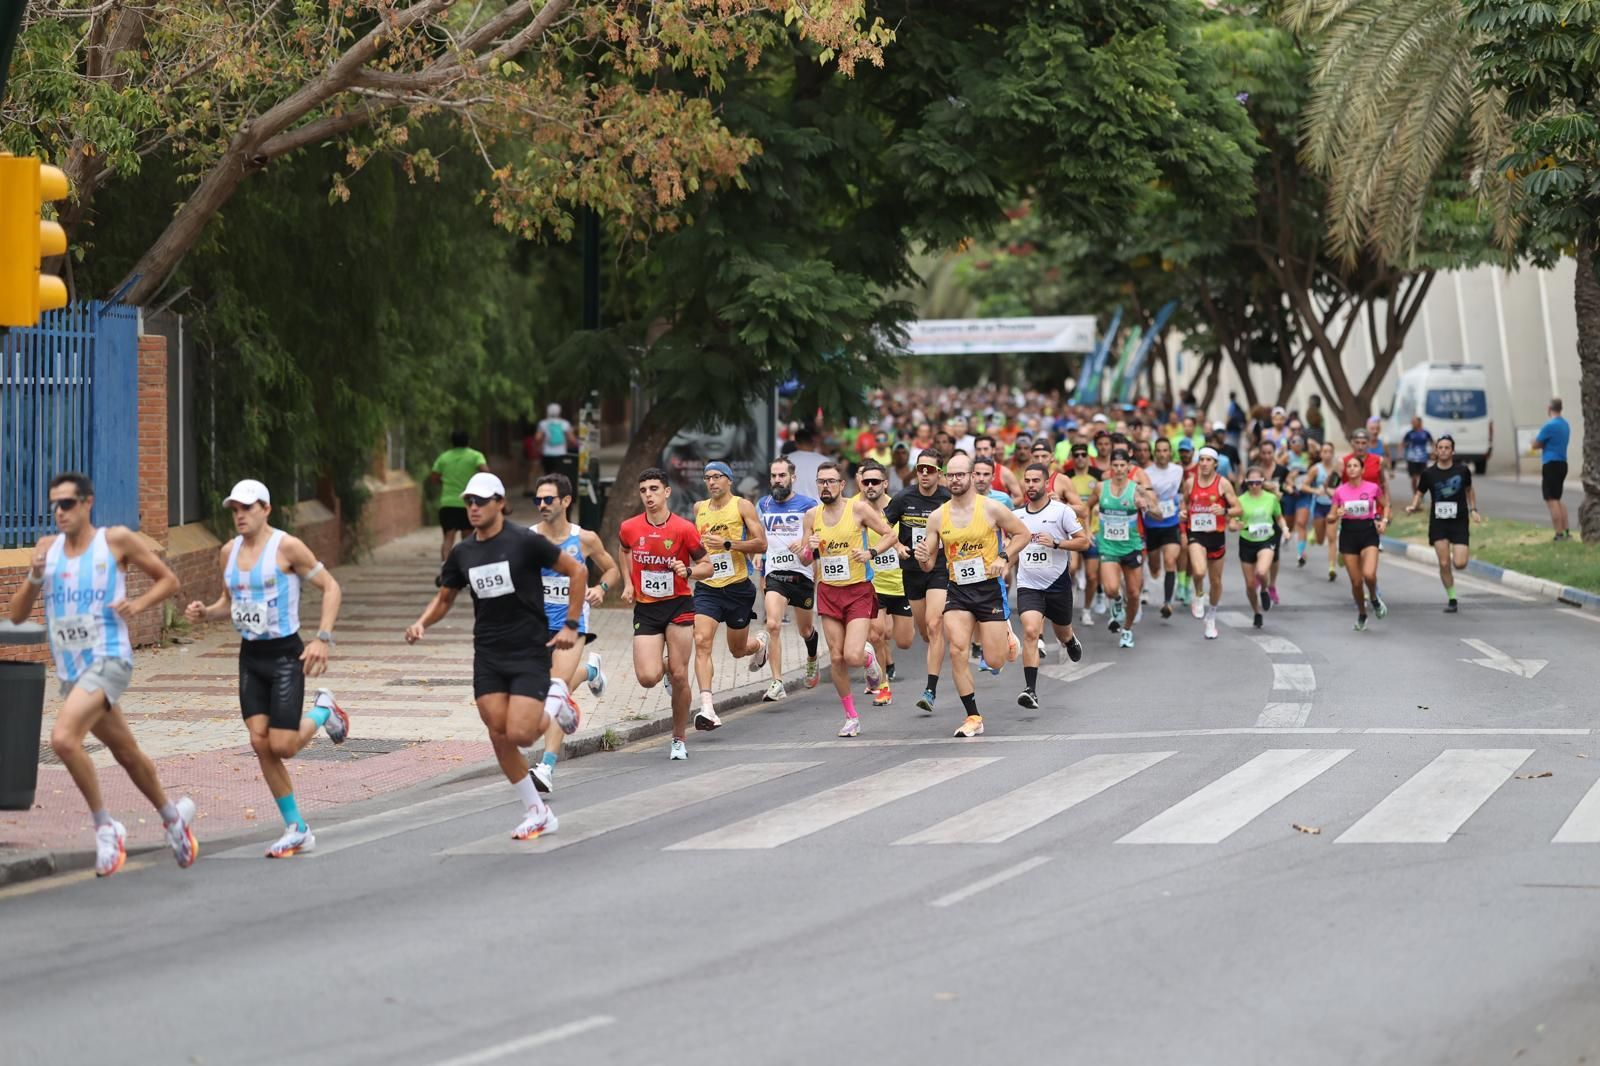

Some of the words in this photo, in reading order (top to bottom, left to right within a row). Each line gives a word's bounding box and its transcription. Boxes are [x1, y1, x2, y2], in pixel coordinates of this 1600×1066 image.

[1194, 518, 1213, 527] 624
[1107, 528, 1126, 536] 403
[771, 554, 795, 564] 1200
[874, 554, 896, 565] 885
[1025, 552, 1048, 562] 790
[824, 564, 845, 574] 692
[960, 567, 976, 578] 33
[475, 574, 505, 590] 859
[645, 579, 668, 590] 241
[543, 585, 570, 597] 510
[235, 611, 261, 624] 344
[57, 625, 89, 641] 125
